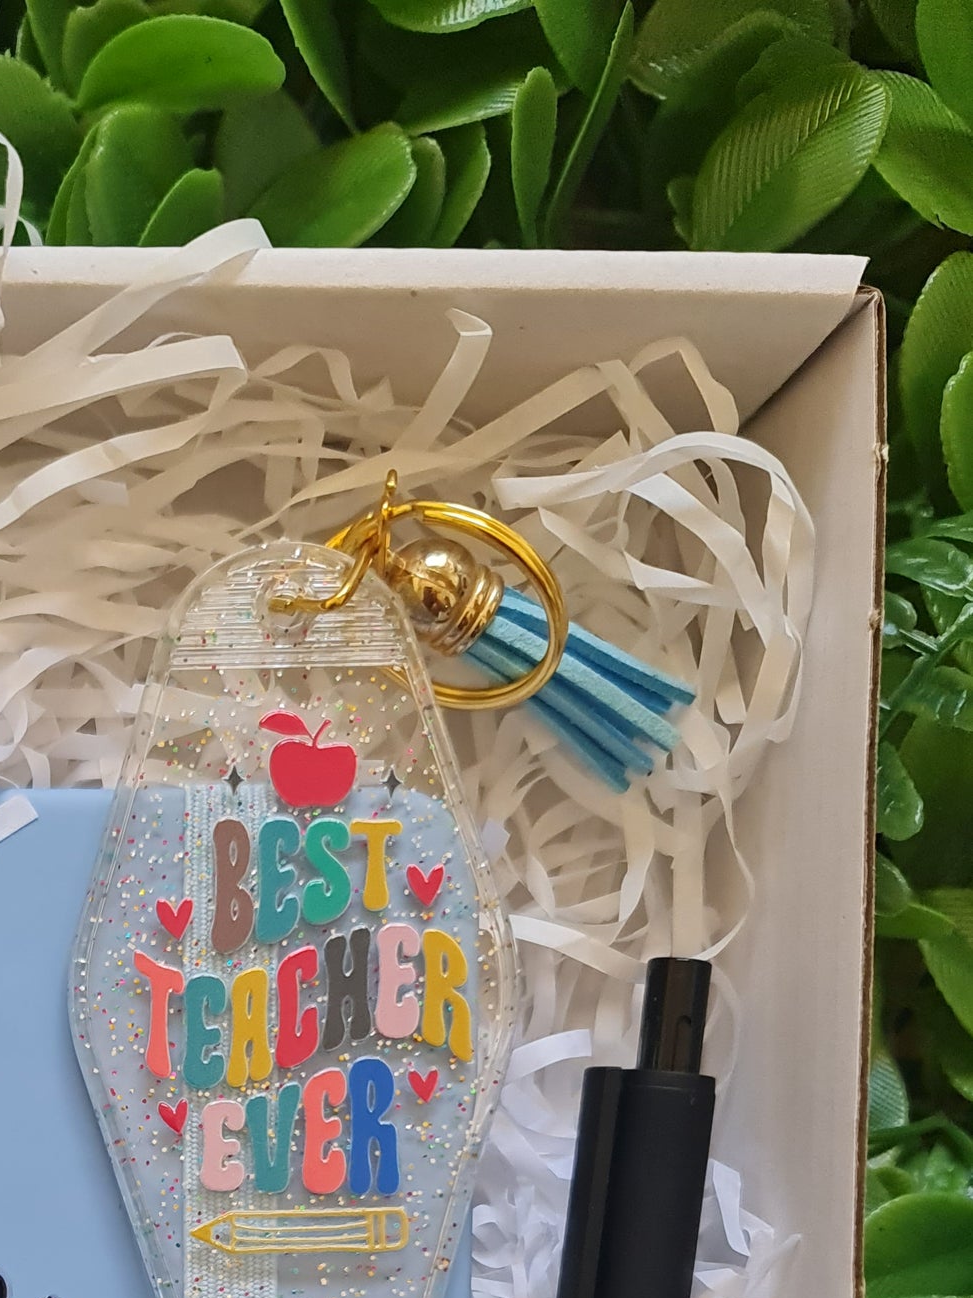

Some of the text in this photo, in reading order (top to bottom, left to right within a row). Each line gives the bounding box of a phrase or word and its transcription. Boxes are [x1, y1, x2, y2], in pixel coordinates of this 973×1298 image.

[211, 816, 403, 953] BEST
[133, 923, 473, 1089] TEACHER
[200, 1056, 401, 1195] EVER
